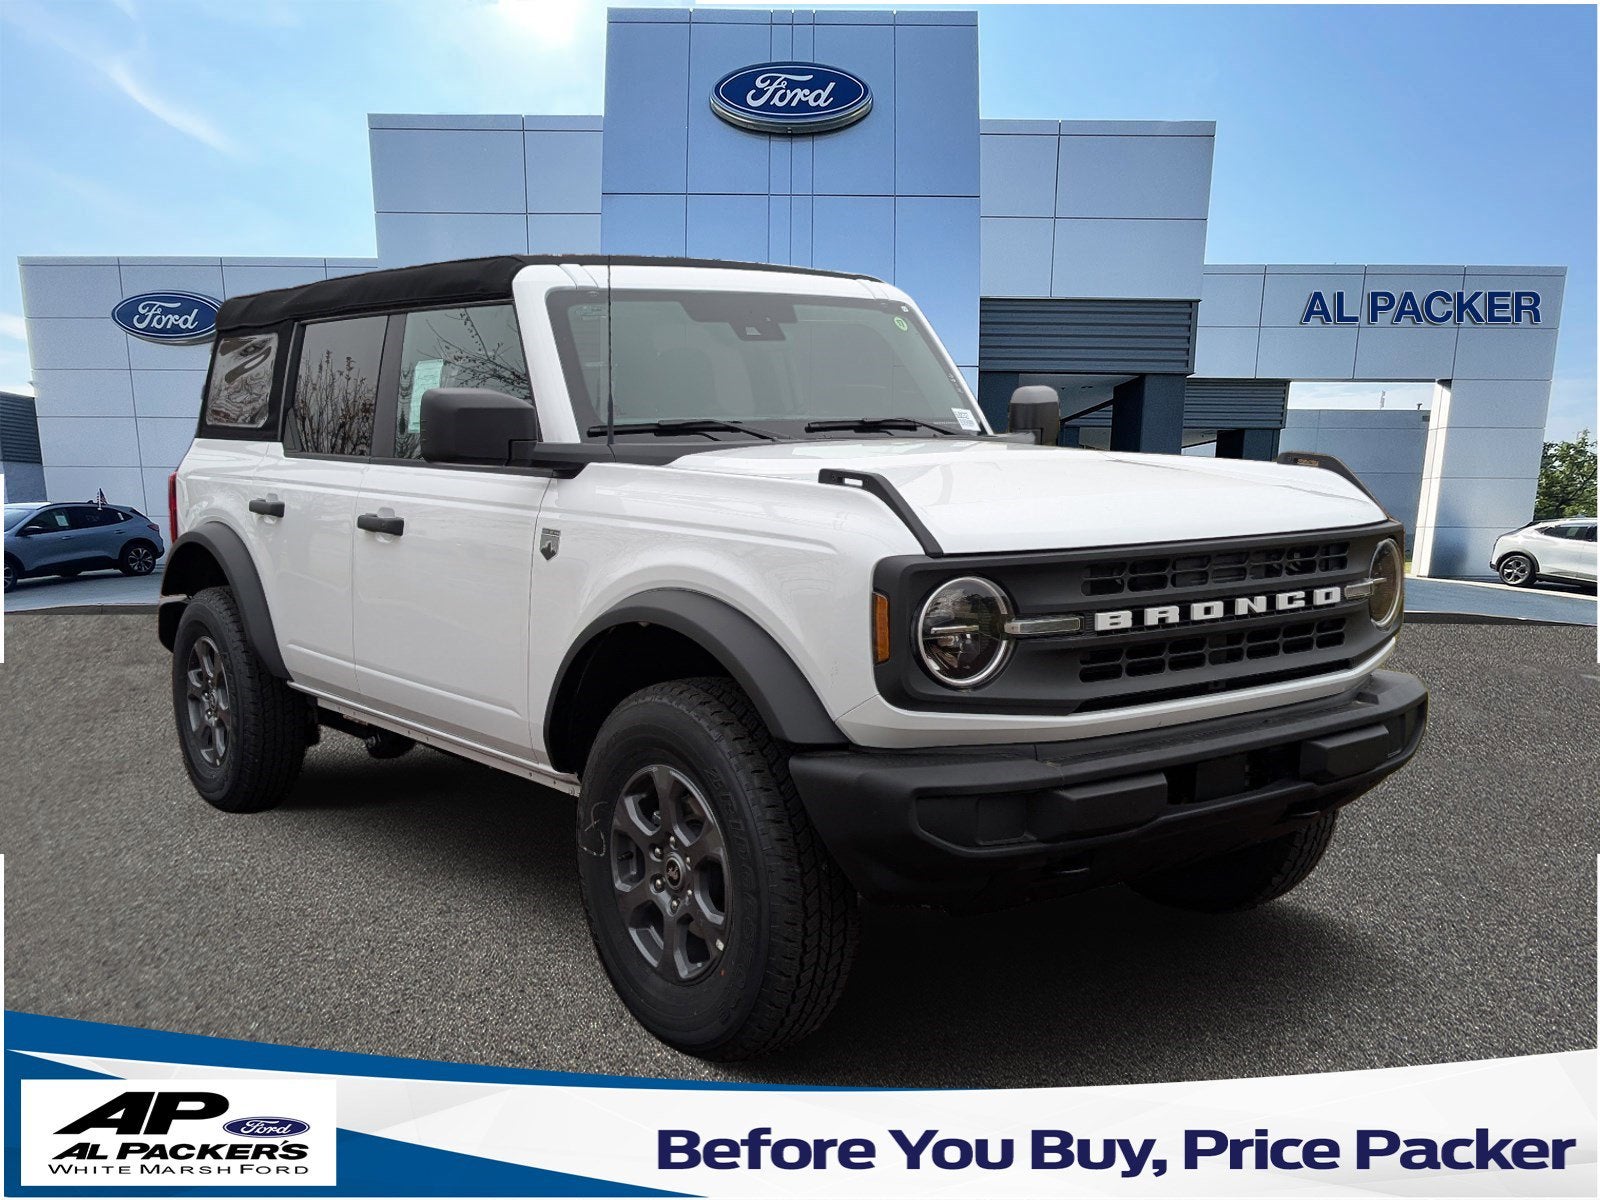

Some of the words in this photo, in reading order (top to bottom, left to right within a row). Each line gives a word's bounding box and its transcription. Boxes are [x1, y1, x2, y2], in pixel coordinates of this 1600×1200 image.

[746, 73, 836, 108] Ford
[133, 301, 199, 329] Ford
[1302, 291, 1359, 324] AL
[1369, 290, 1541, 324] PACKER
[1095, 587, 1341, 631] BRONCO
